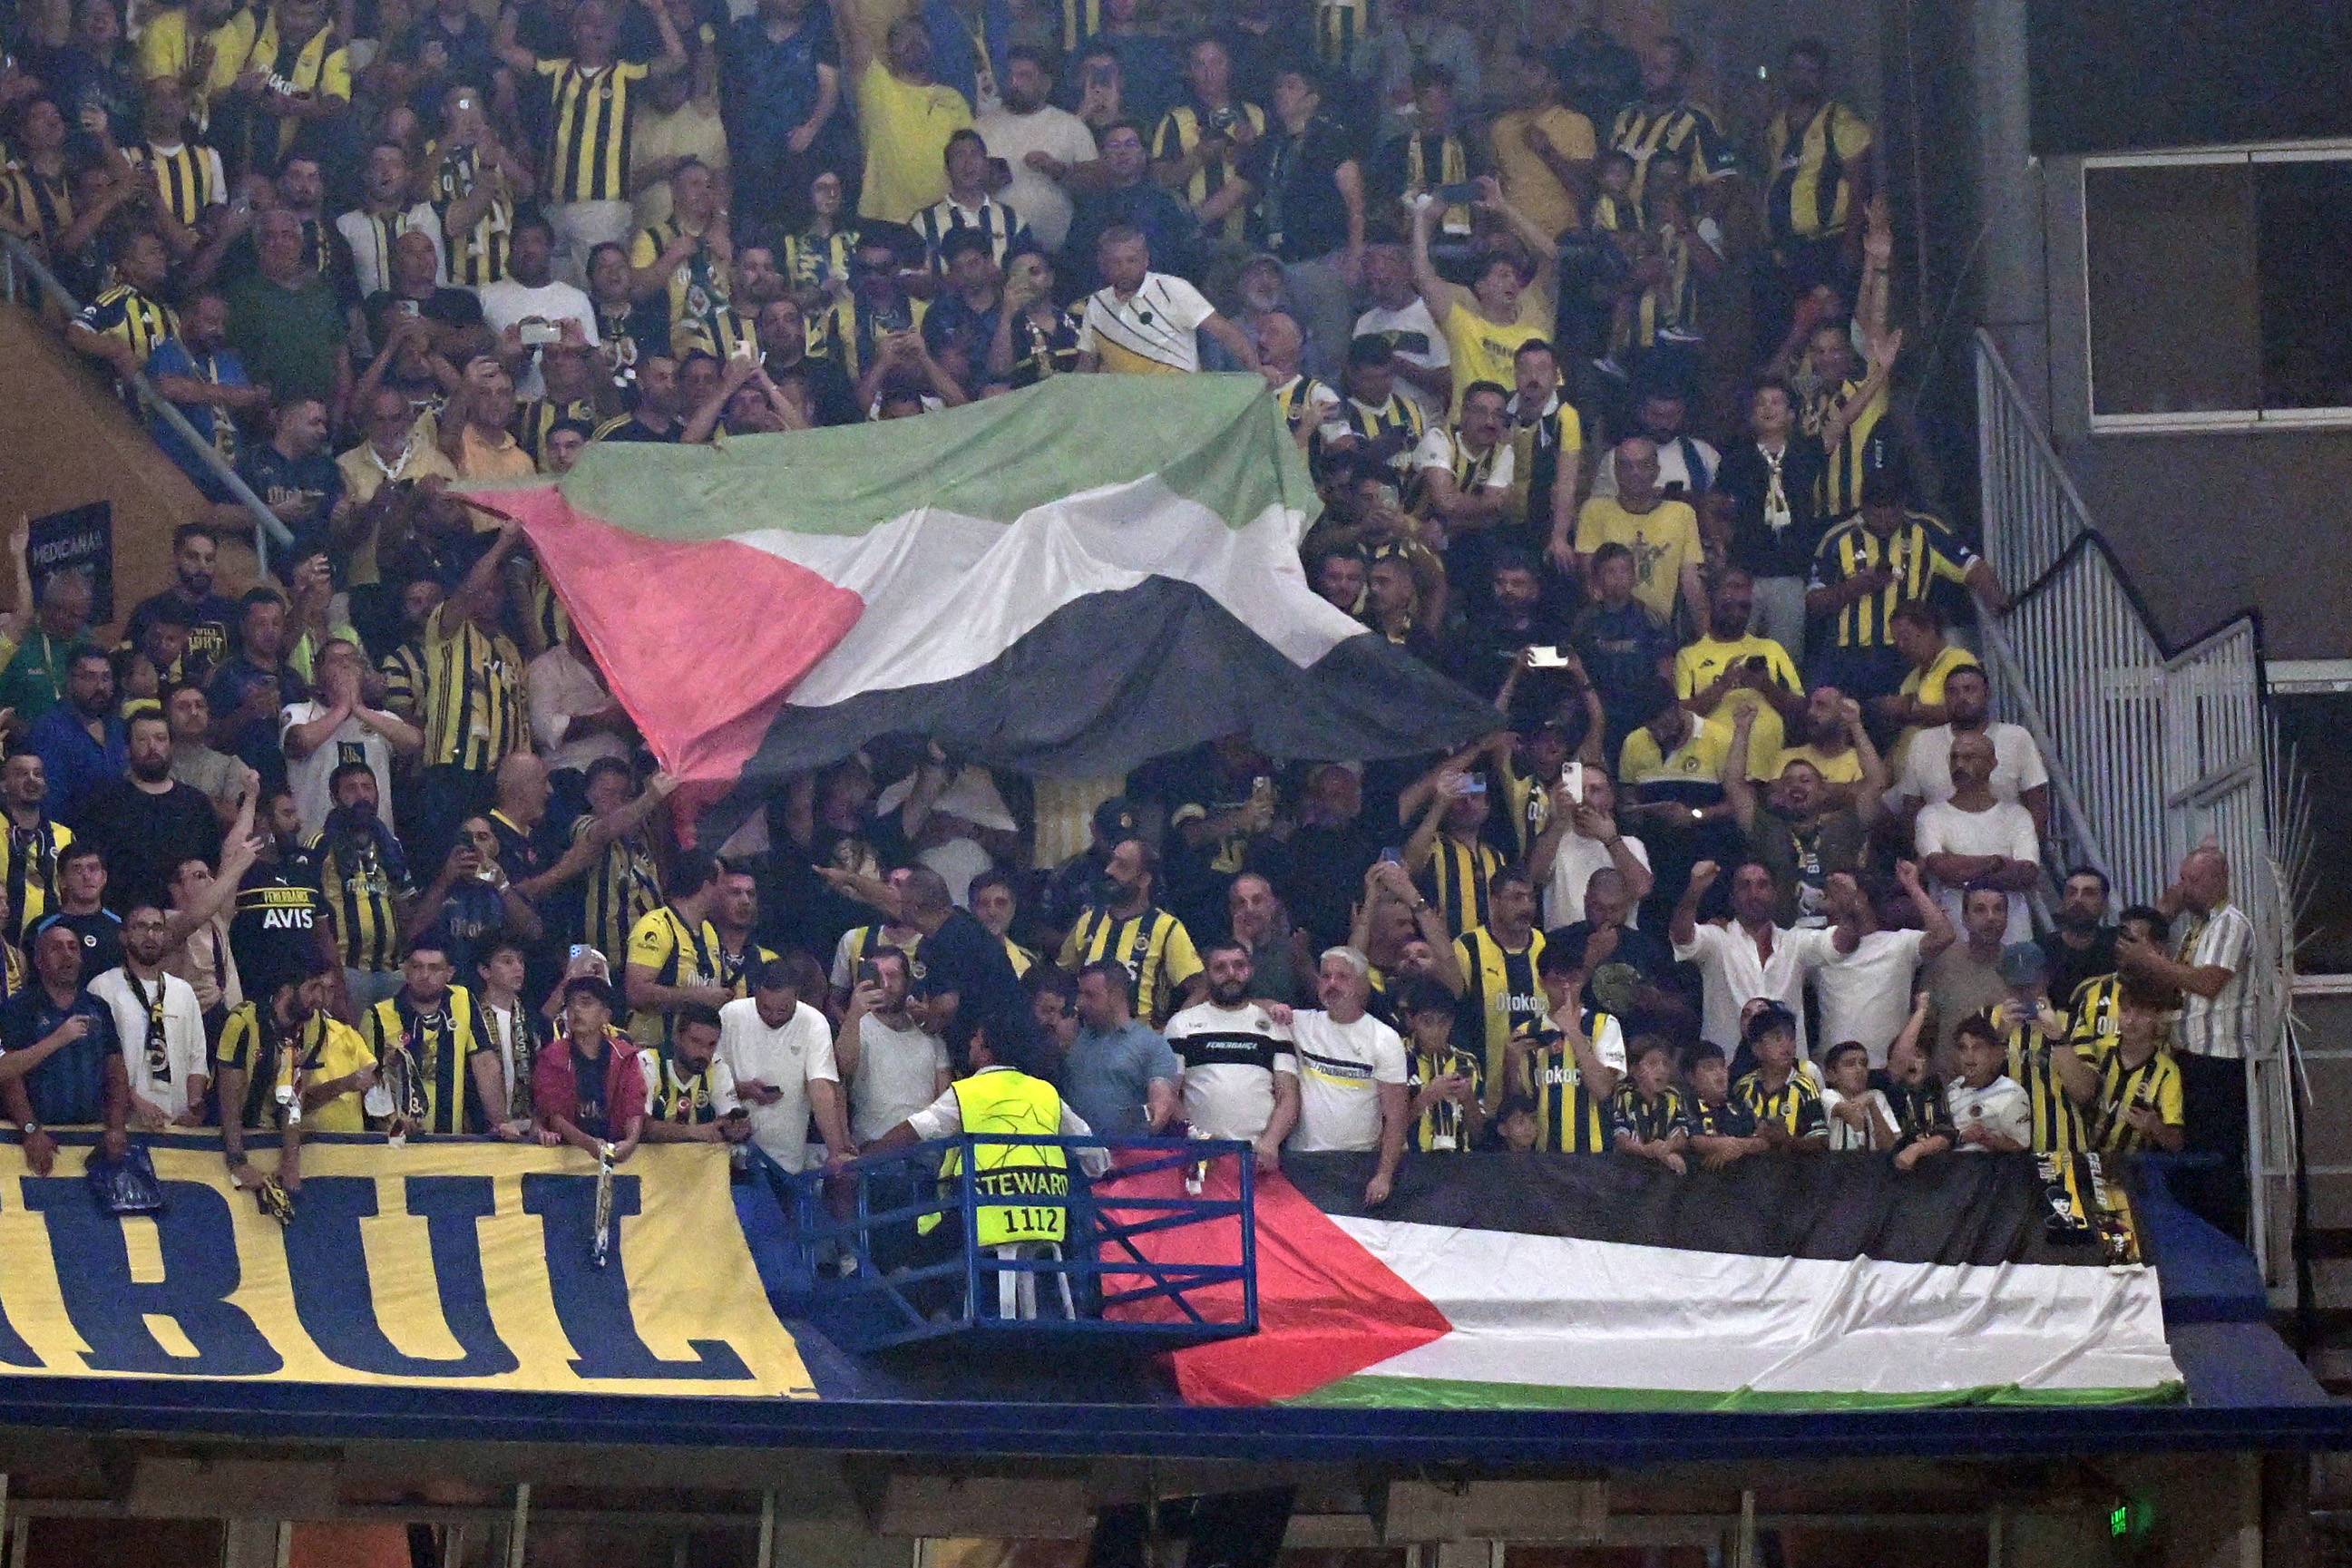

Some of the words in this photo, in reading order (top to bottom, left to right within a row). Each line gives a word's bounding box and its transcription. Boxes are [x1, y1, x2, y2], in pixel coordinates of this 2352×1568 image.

[263, 909, 314, 930] AVIS
[1003, 1208, 1059, 1234] 1112
[0, 1172, 756, 1381] BUL
